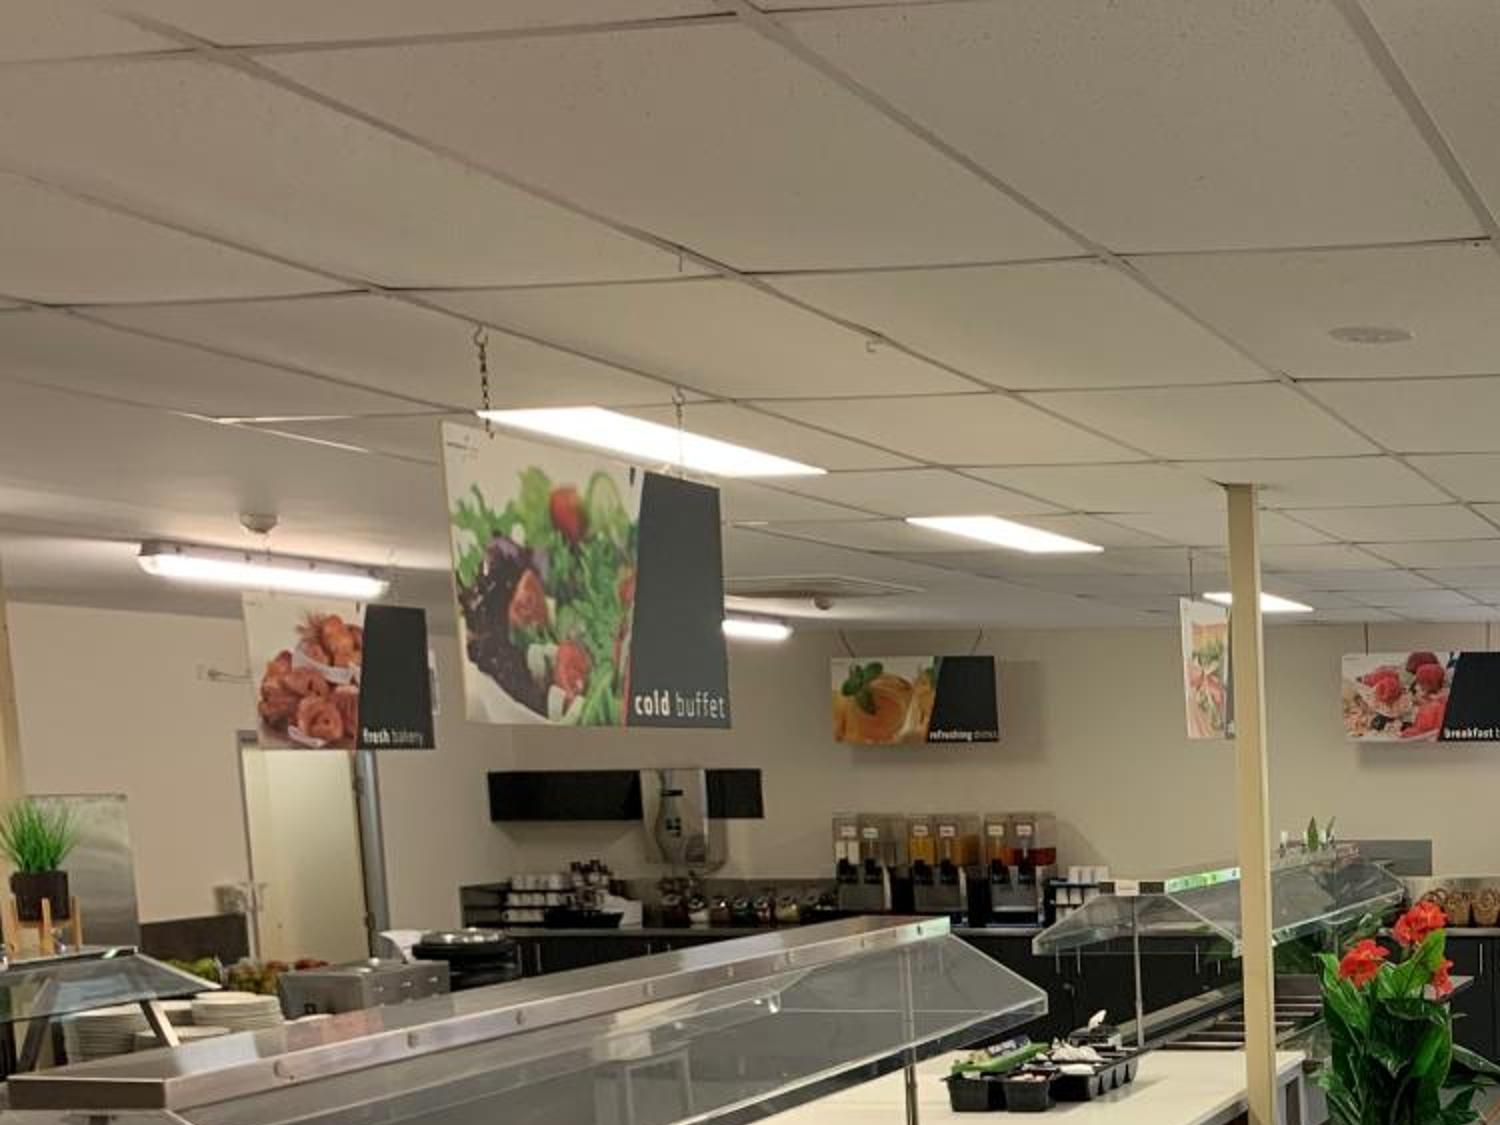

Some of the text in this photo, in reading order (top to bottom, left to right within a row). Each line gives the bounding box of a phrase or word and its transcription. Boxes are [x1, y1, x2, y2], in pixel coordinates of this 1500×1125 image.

[634, 689, 726, 719] cold buffet
[363, 726, 391, 744] fresh
[1444, 727, 1494, 739] breakfast
